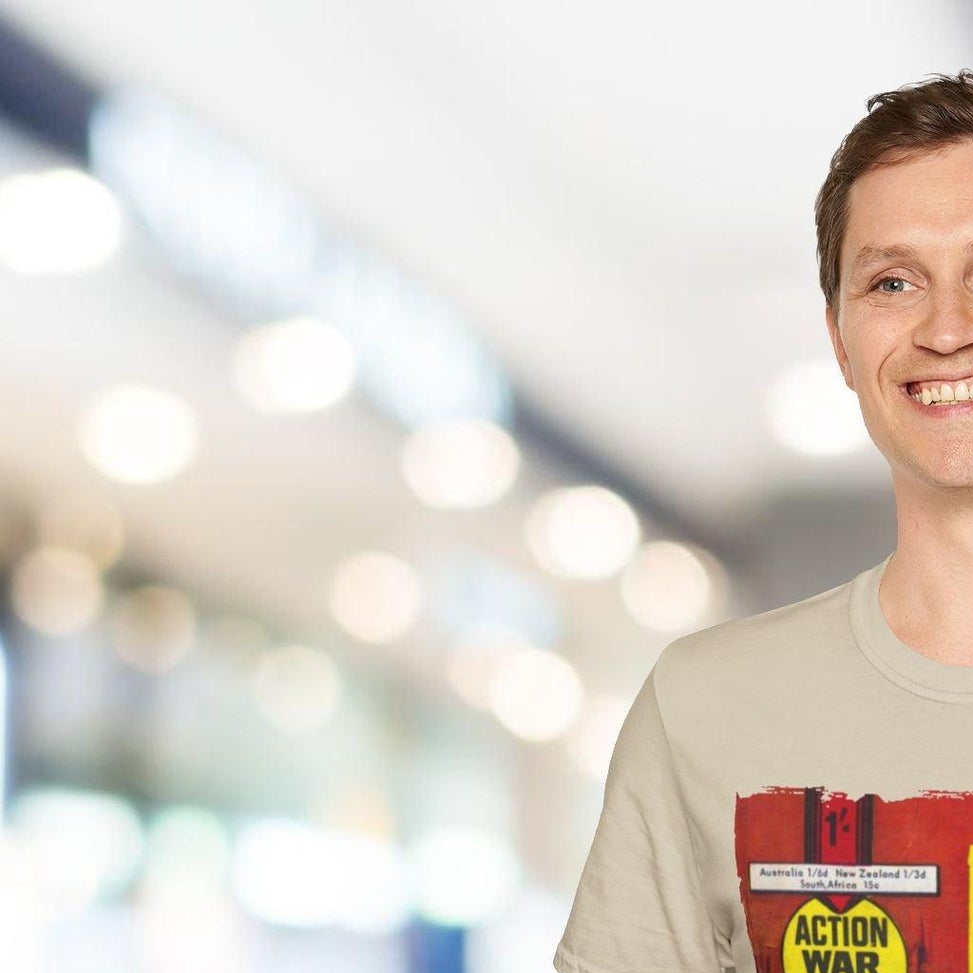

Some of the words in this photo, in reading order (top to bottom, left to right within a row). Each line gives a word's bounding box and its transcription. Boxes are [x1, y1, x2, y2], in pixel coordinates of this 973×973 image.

[760, 867, 804, 877] Australia
[808, 867, 828, 877] 1/6d
[835, 868, 856, 878] New
[859, 869, 900, 879] Zealand
[903, 869, 926, 879] 1/3d
[827, 880, 857, 889] Africa
[864, 880, 880, 889] 15c
[795, 915, 888, 948] ACTION
